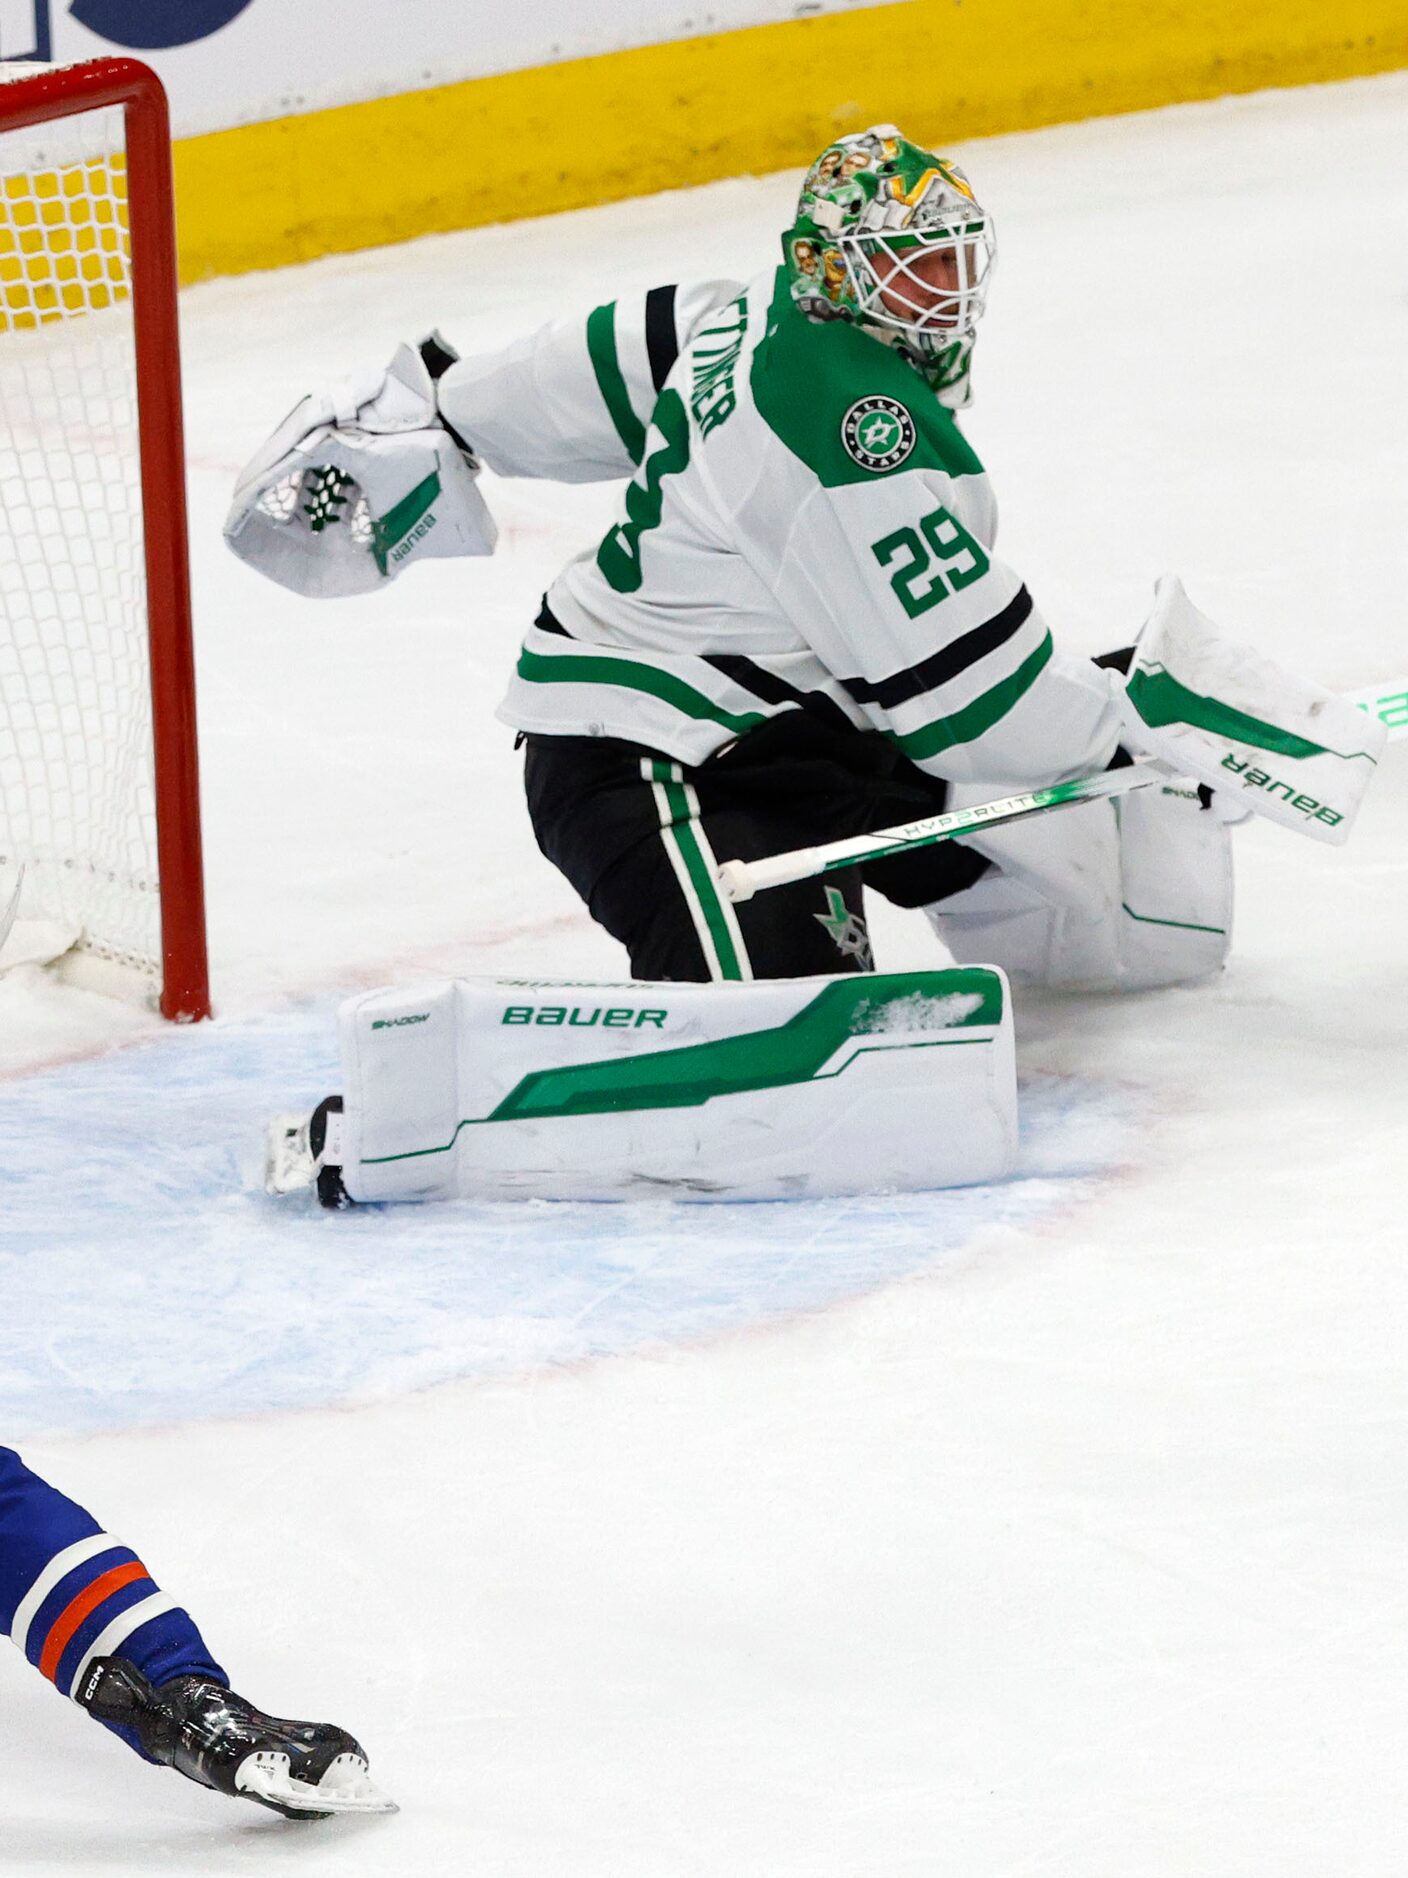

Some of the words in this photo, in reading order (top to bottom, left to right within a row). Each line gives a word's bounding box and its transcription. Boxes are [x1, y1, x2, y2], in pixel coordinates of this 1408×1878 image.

[846, 400, 909, 434] DALLAS
[854, 441, 910, 467] STARS
[871, 506, 990, 620] 29
[85, 1665, 104, 1700] CCM
